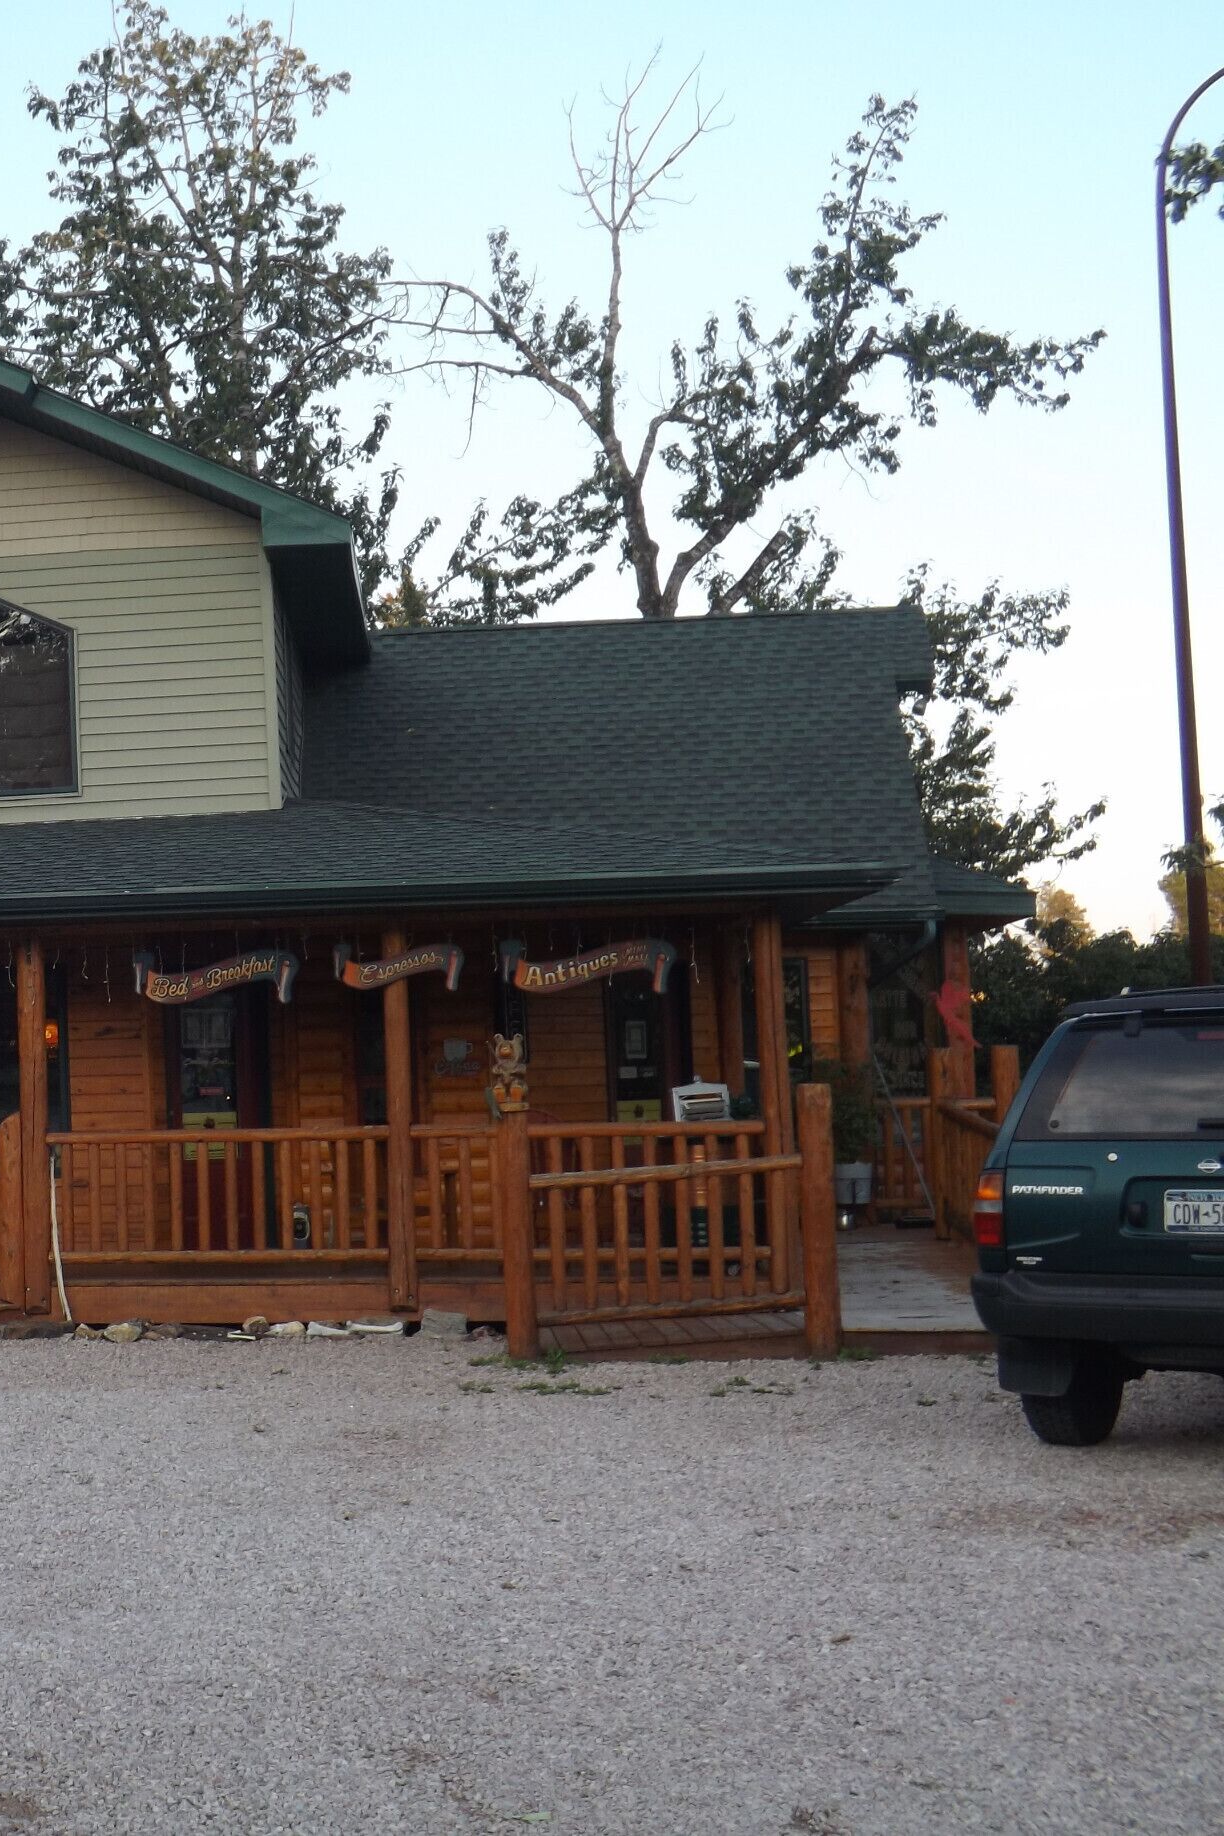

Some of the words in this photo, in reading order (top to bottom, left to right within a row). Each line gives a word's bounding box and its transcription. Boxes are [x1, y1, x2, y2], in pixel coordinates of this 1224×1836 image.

[151, 975, 189, 998] Bed
[206, 956, 275, 988] Breakfast
[525, 952, 619, 986] Antiques
[1012, 1185, 1085, 1195] PATHFINDER
